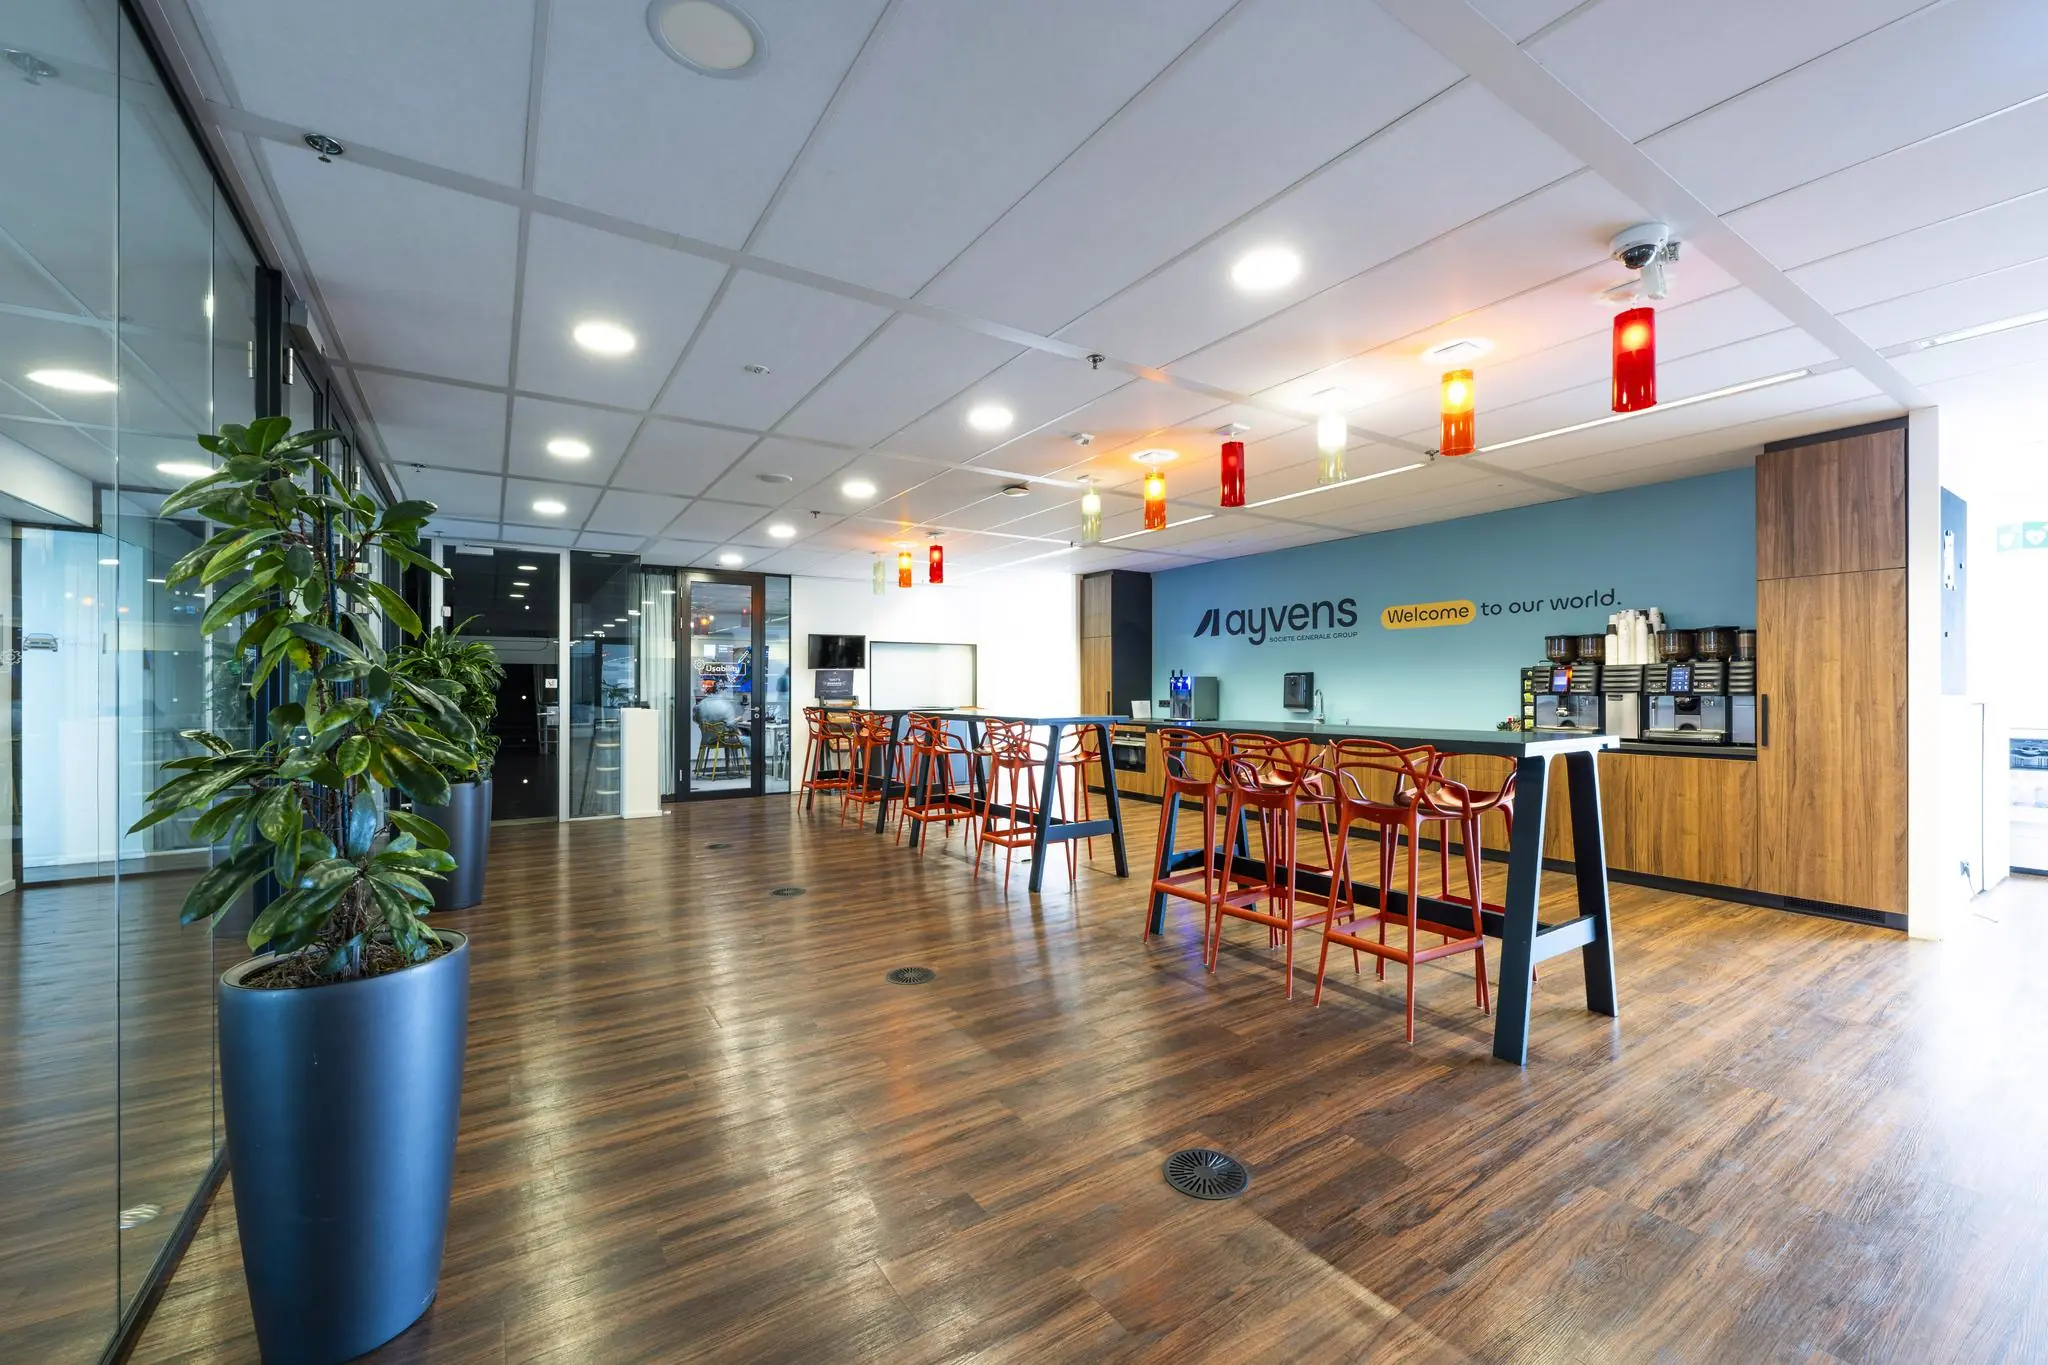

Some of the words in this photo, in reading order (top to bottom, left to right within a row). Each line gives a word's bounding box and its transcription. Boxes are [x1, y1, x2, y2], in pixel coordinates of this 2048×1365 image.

[1387, 606, 1469, 624] Welcome
[1481, 601, 1502, 616] to
[1509, 599, 1544, 614] our
[1550, 588, 1622, 611] world.
[1226, 598, 1358, 646] ayvens
[1333, 631, 1358, 639] GROUP
[705, 665, 740, 674] Usability
